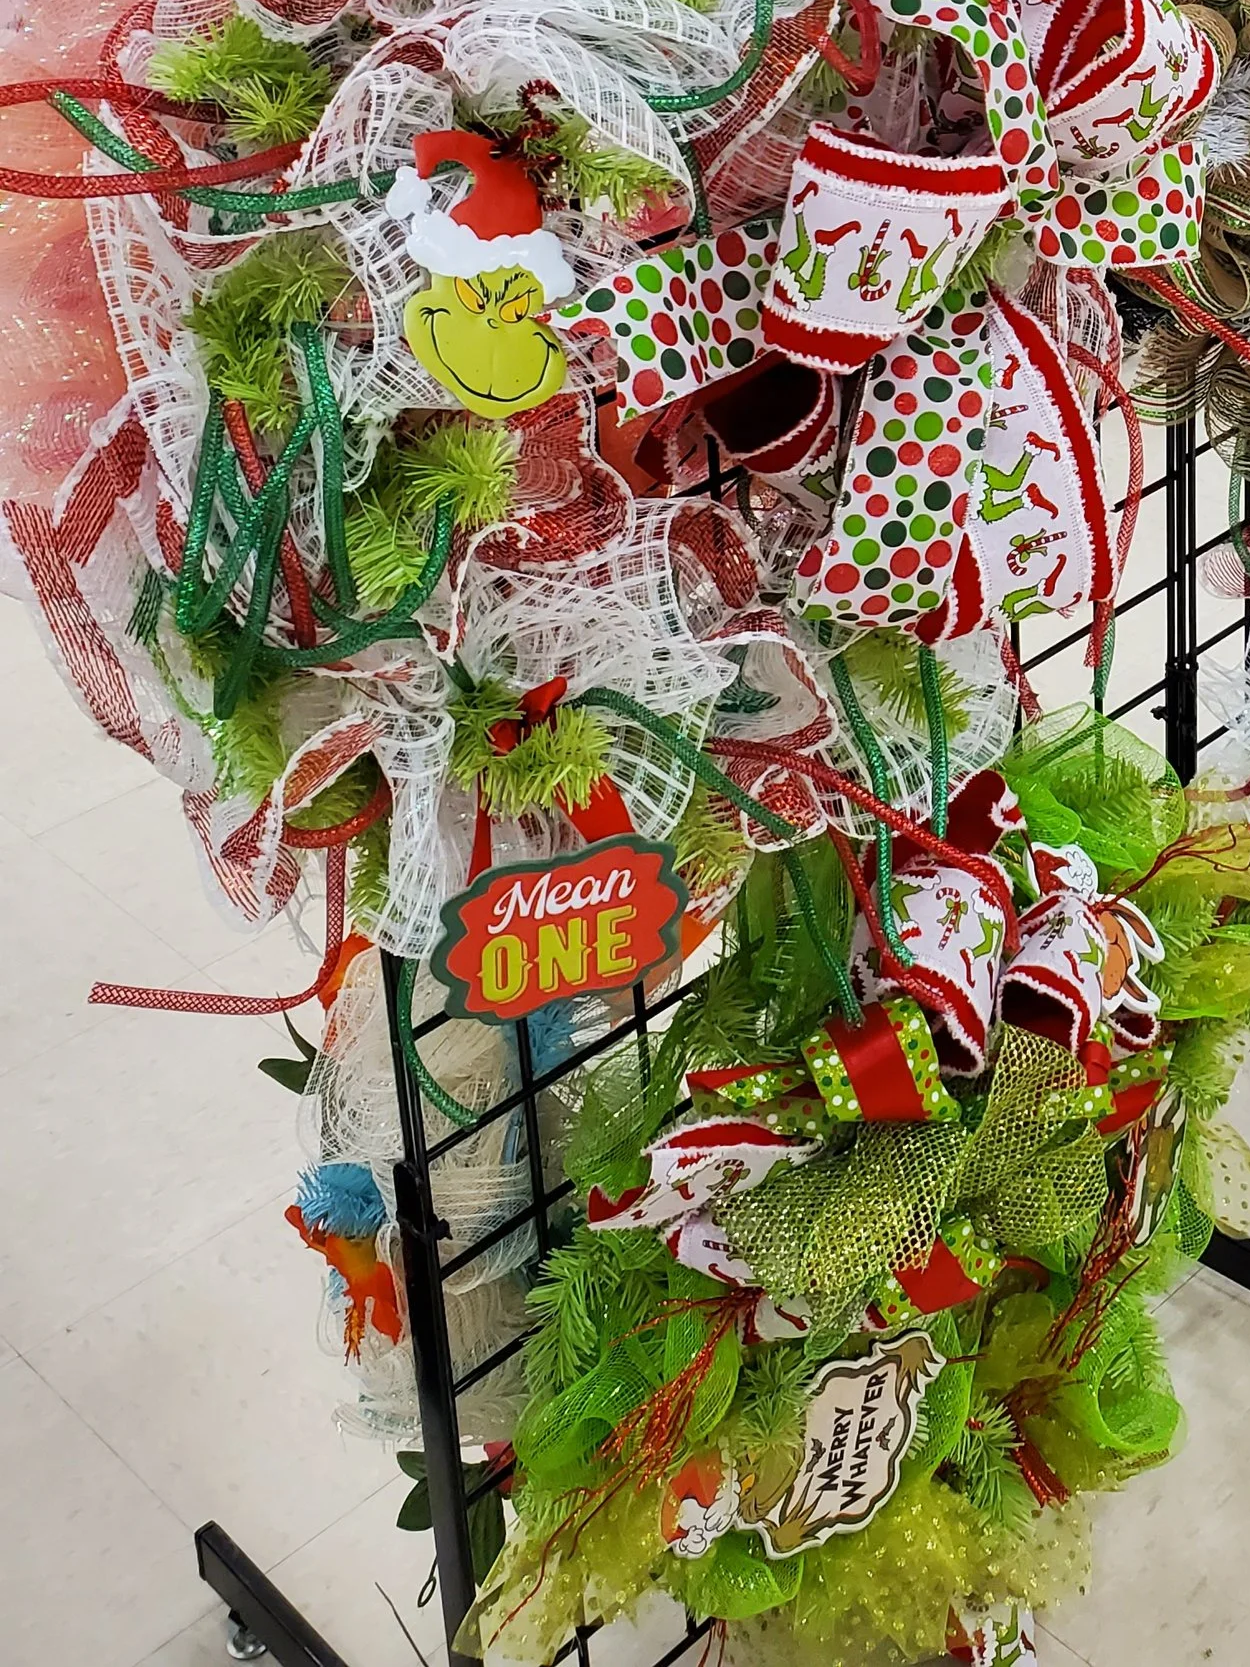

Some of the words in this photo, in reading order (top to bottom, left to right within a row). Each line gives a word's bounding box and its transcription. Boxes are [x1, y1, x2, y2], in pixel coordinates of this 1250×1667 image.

[487, 869, 637, 934] Mean
[477, 905, 638, 1005] ONE
[815, 1406, 854, 1492] MERRY
[840, 1370, 889, 1512] WHATEVER
